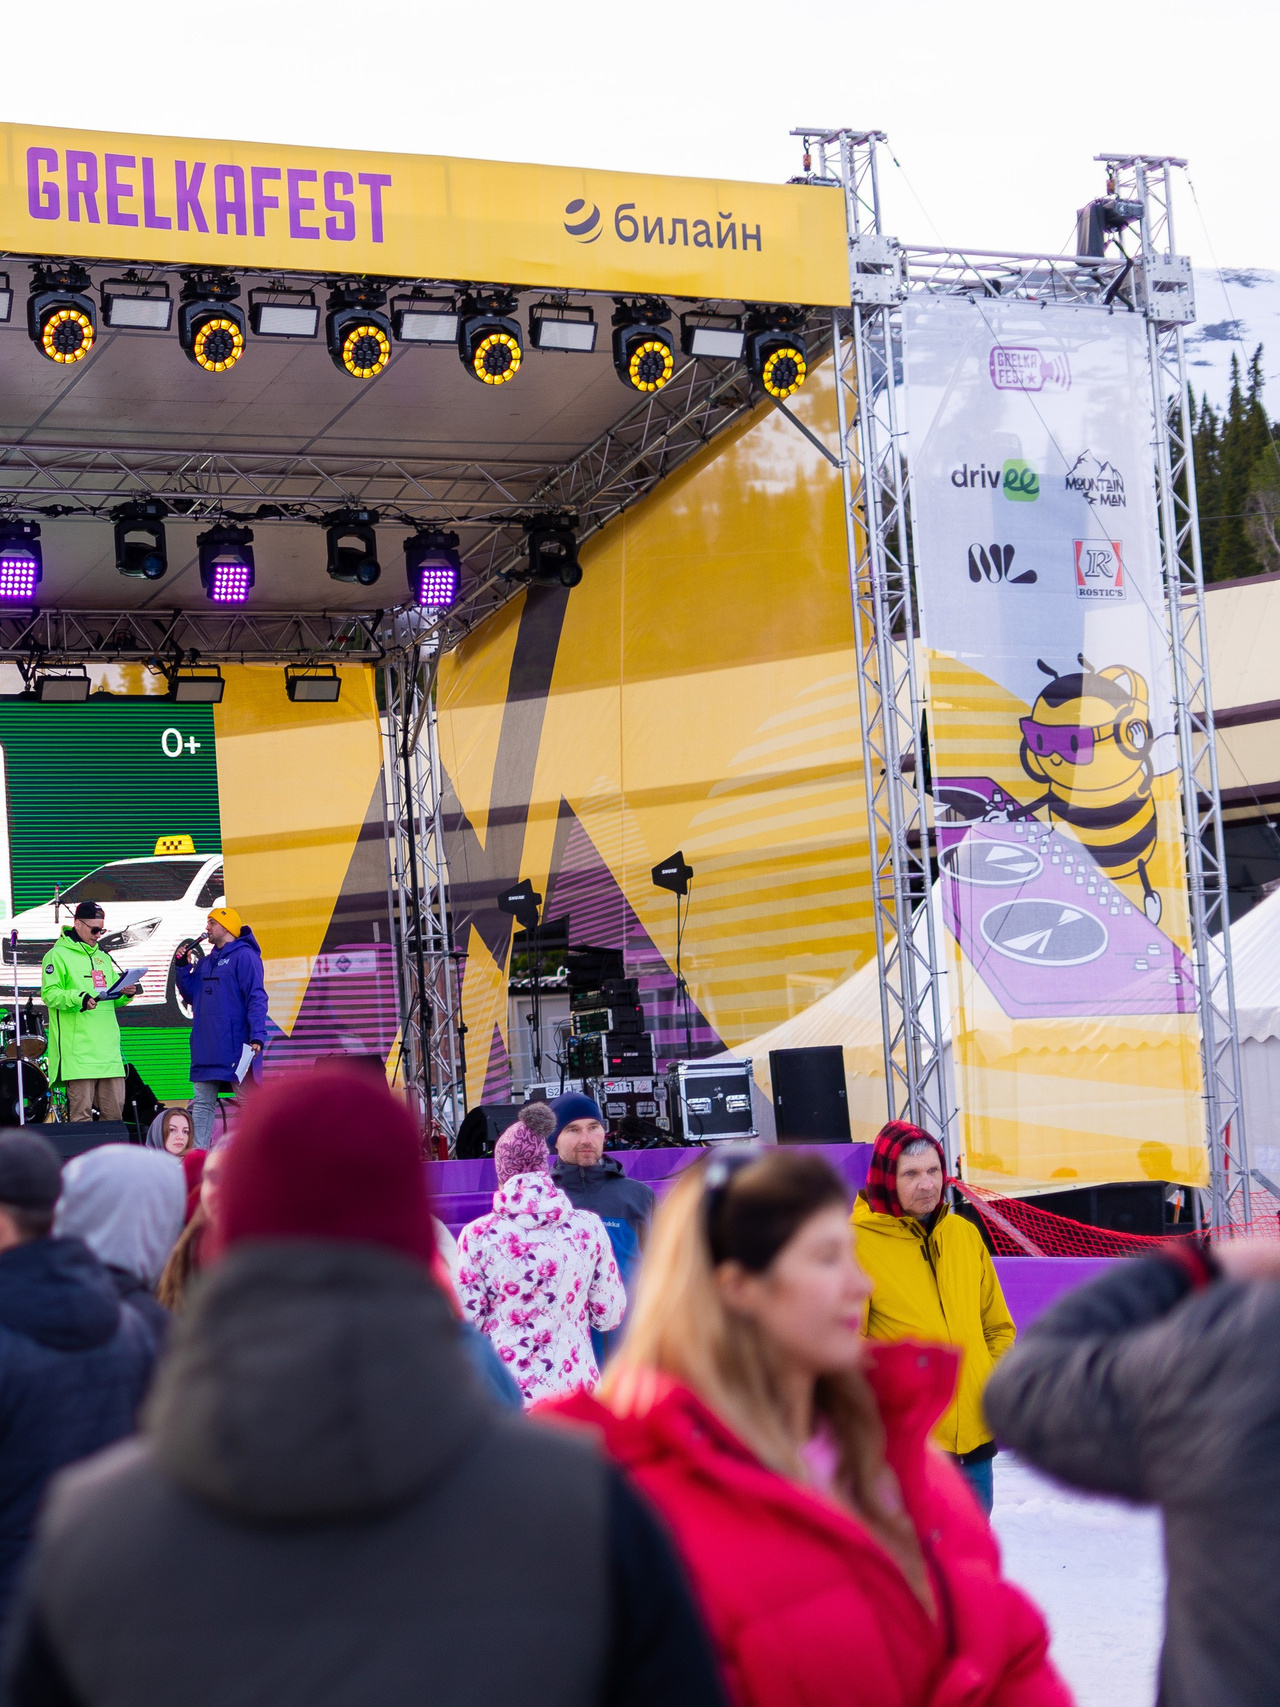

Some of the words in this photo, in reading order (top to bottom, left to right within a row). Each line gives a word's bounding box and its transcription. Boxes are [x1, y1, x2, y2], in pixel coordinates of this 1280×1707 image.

[26, 146, 392, 243] GRELKAFEST
[614, 202, 762, 252] билайн
[997, 352, 1038, 369] GRELKA
[998, 369, 1025, 384] FEST
[951, 463, 1040, 494] drivee
[1065, 476, 1125, 493] MOUNTAIN
[1100, 493, 1127, 507] MAN
[1085, 549, 1114, 578] R
[1079, 588, 1123, 597] ROSTIC'S
[161, 727, 201, 758] 0+
